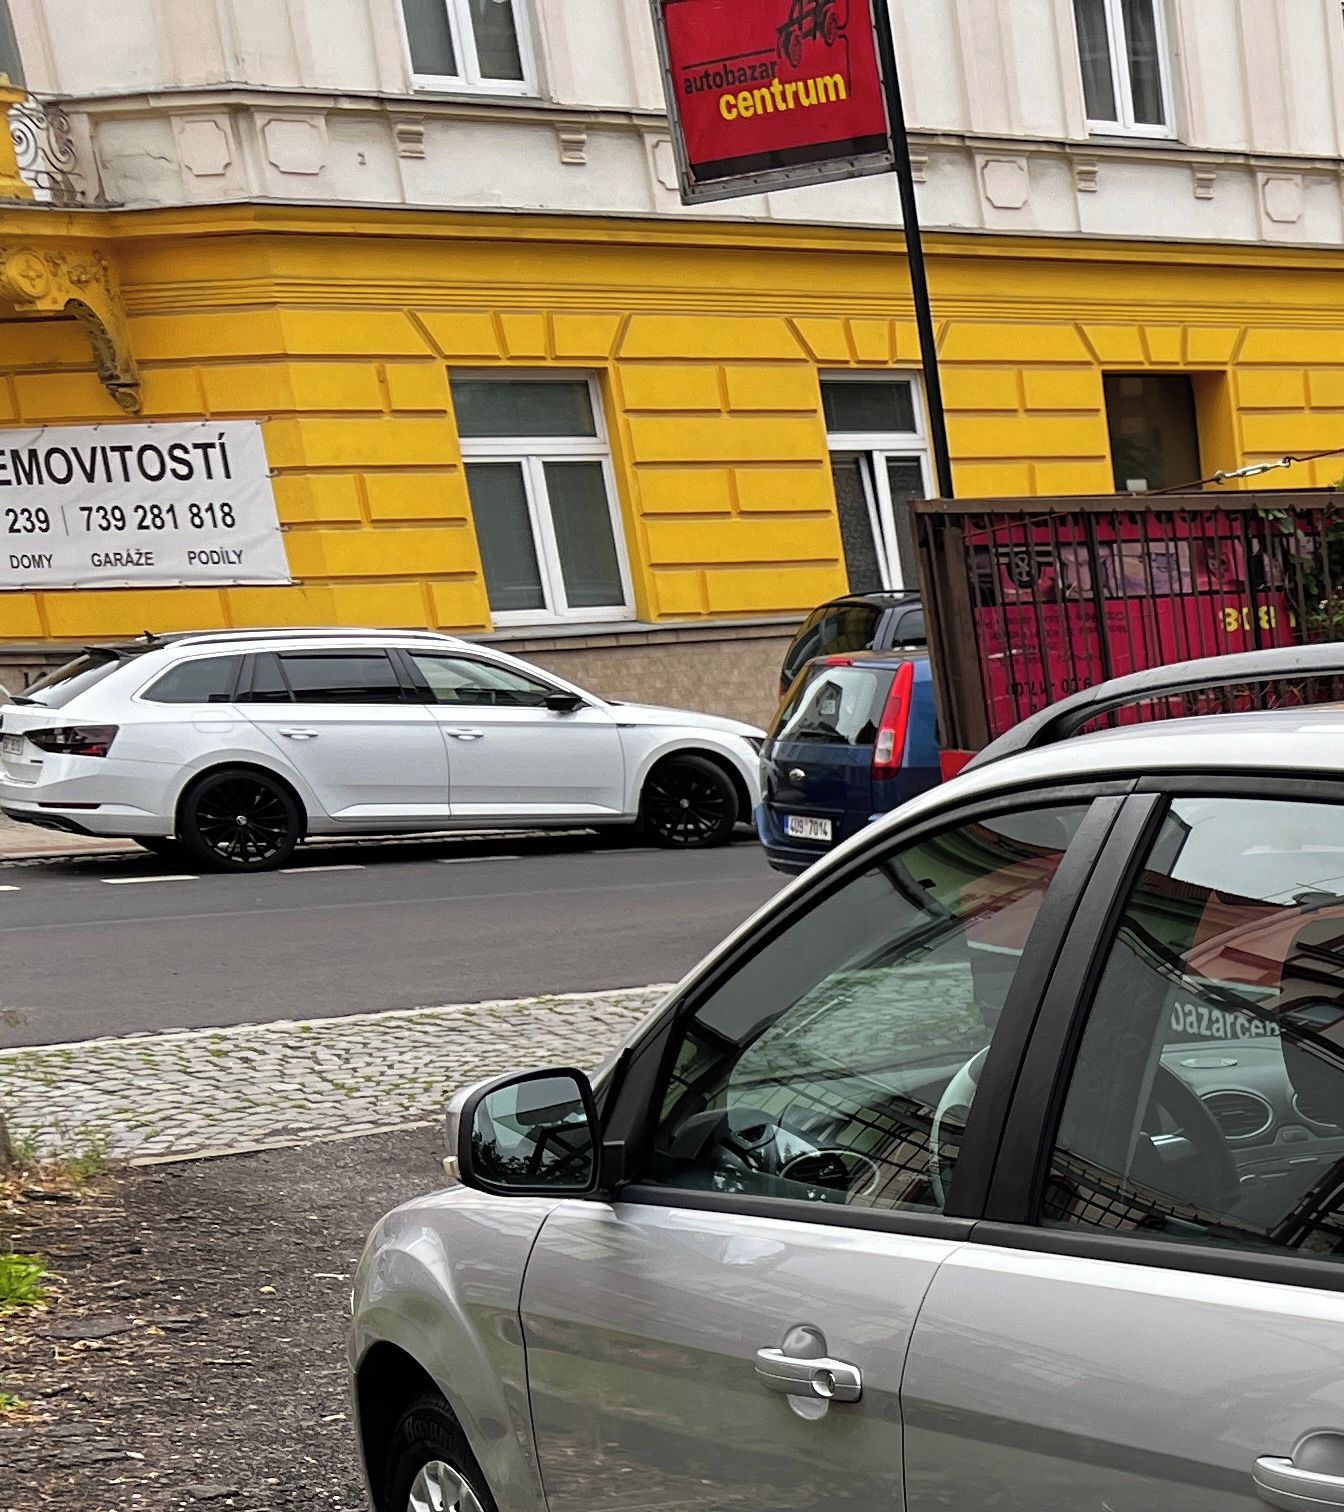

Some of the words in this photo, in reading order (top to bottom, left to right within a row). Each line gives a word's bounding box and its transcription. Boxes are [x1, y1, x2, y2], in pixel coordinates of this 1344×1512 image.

[684, 60, 778, 95] autobazar
[719, 73, 848, 121] centrum
[5, 507, 50, 534] 239
[79, 505, 126, 532] 739
[133, 504, 179, 530] 281
[188, 502, 236, 529] 818
[9, 554, 53, 569] DOMY
[91, 549, 154, 567] GARÁŽE
[187, 546, 243, 565] PODÍLY
[807, 820, 828, 836] 7014
